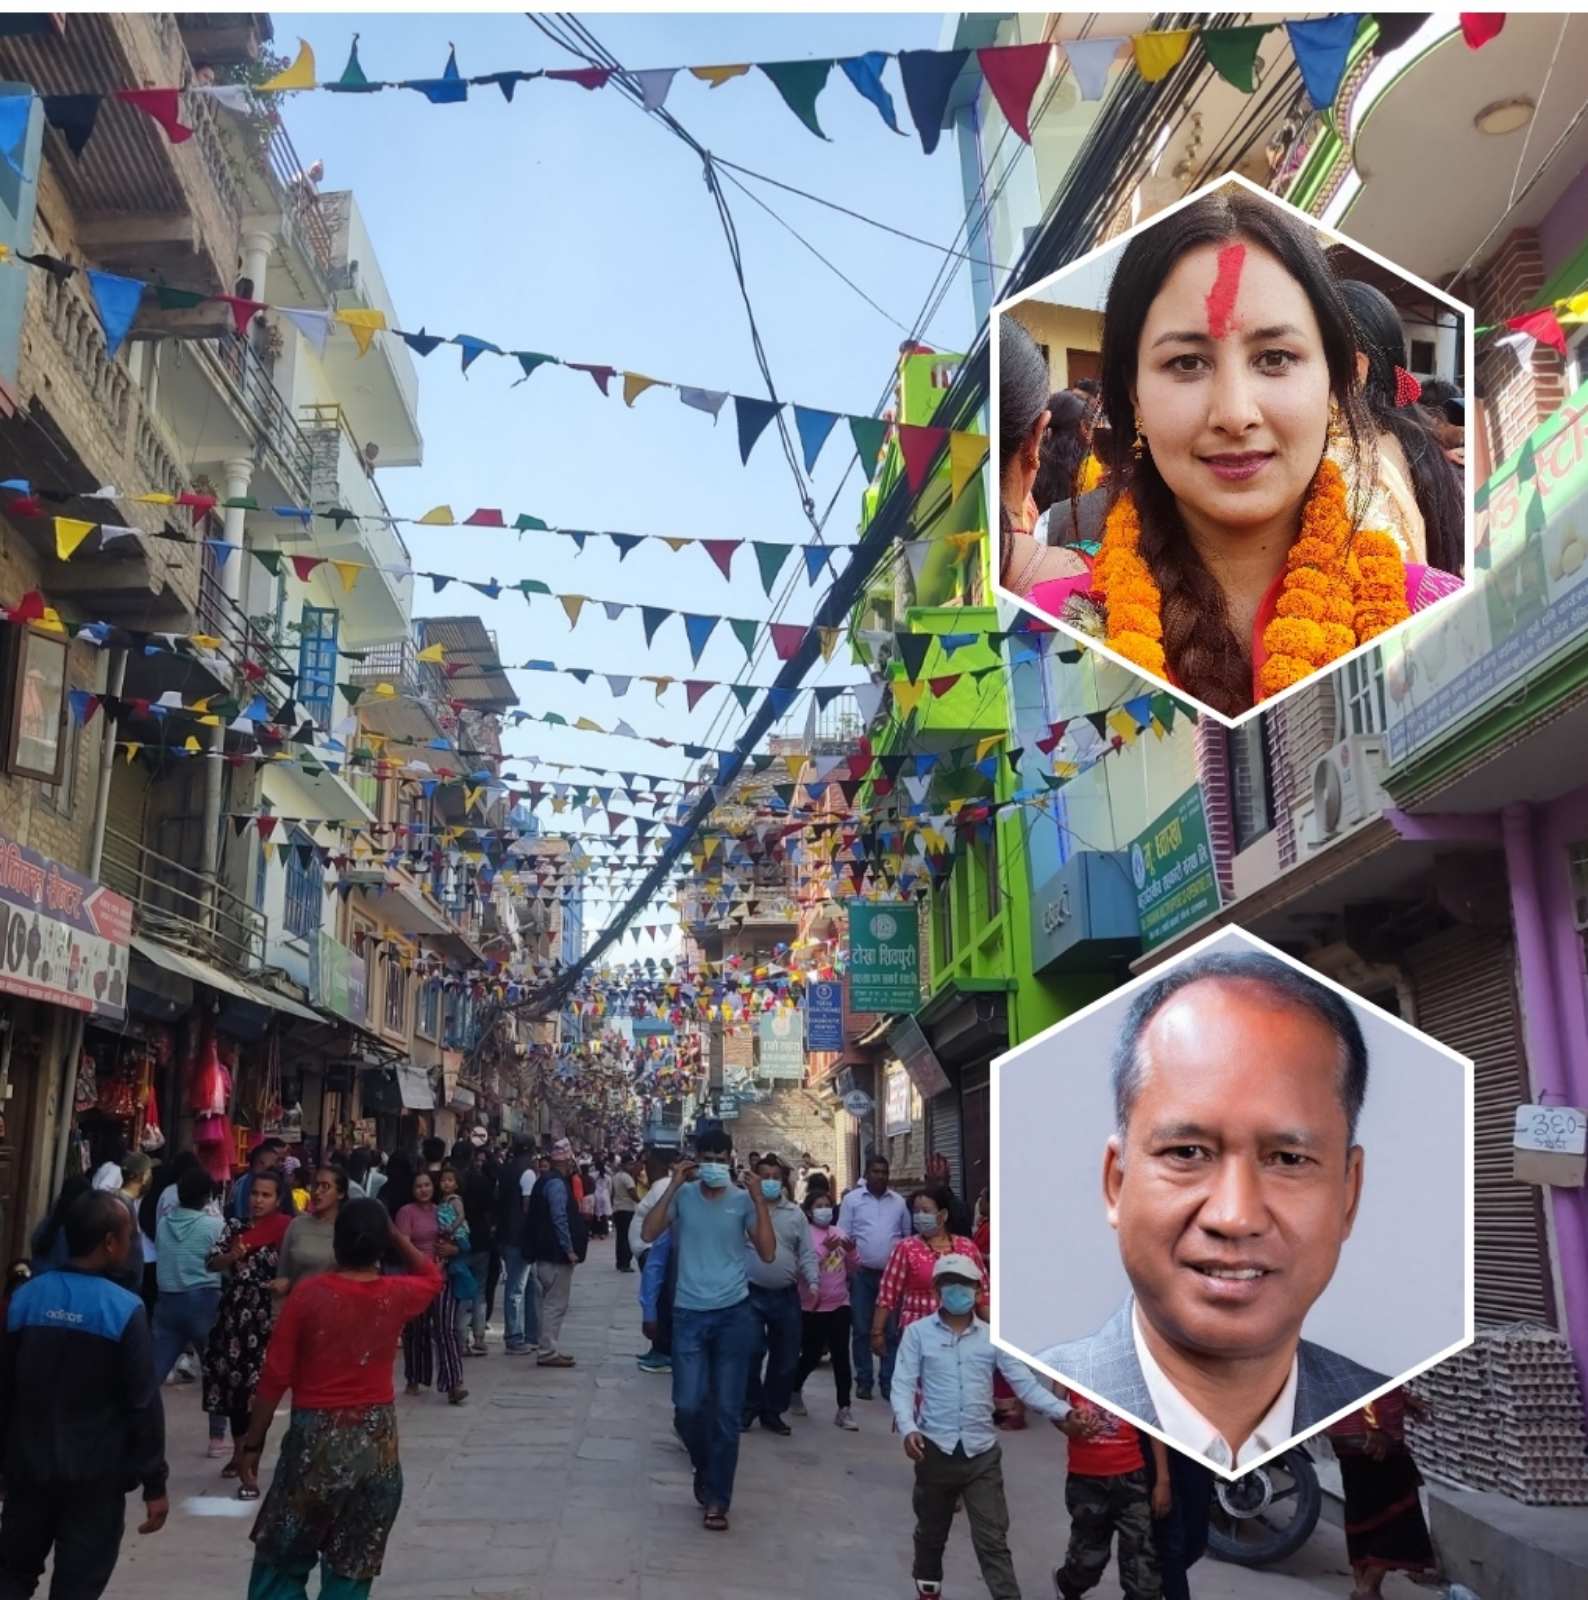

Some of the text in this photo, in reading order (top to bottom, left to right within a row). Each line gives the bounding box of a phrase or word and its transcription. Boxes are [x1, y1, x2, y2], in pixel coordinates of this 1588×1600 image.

[852, 943, 916, 970] टोखा शिवपुरी
[46, 1308, 84, 1323] adidas
